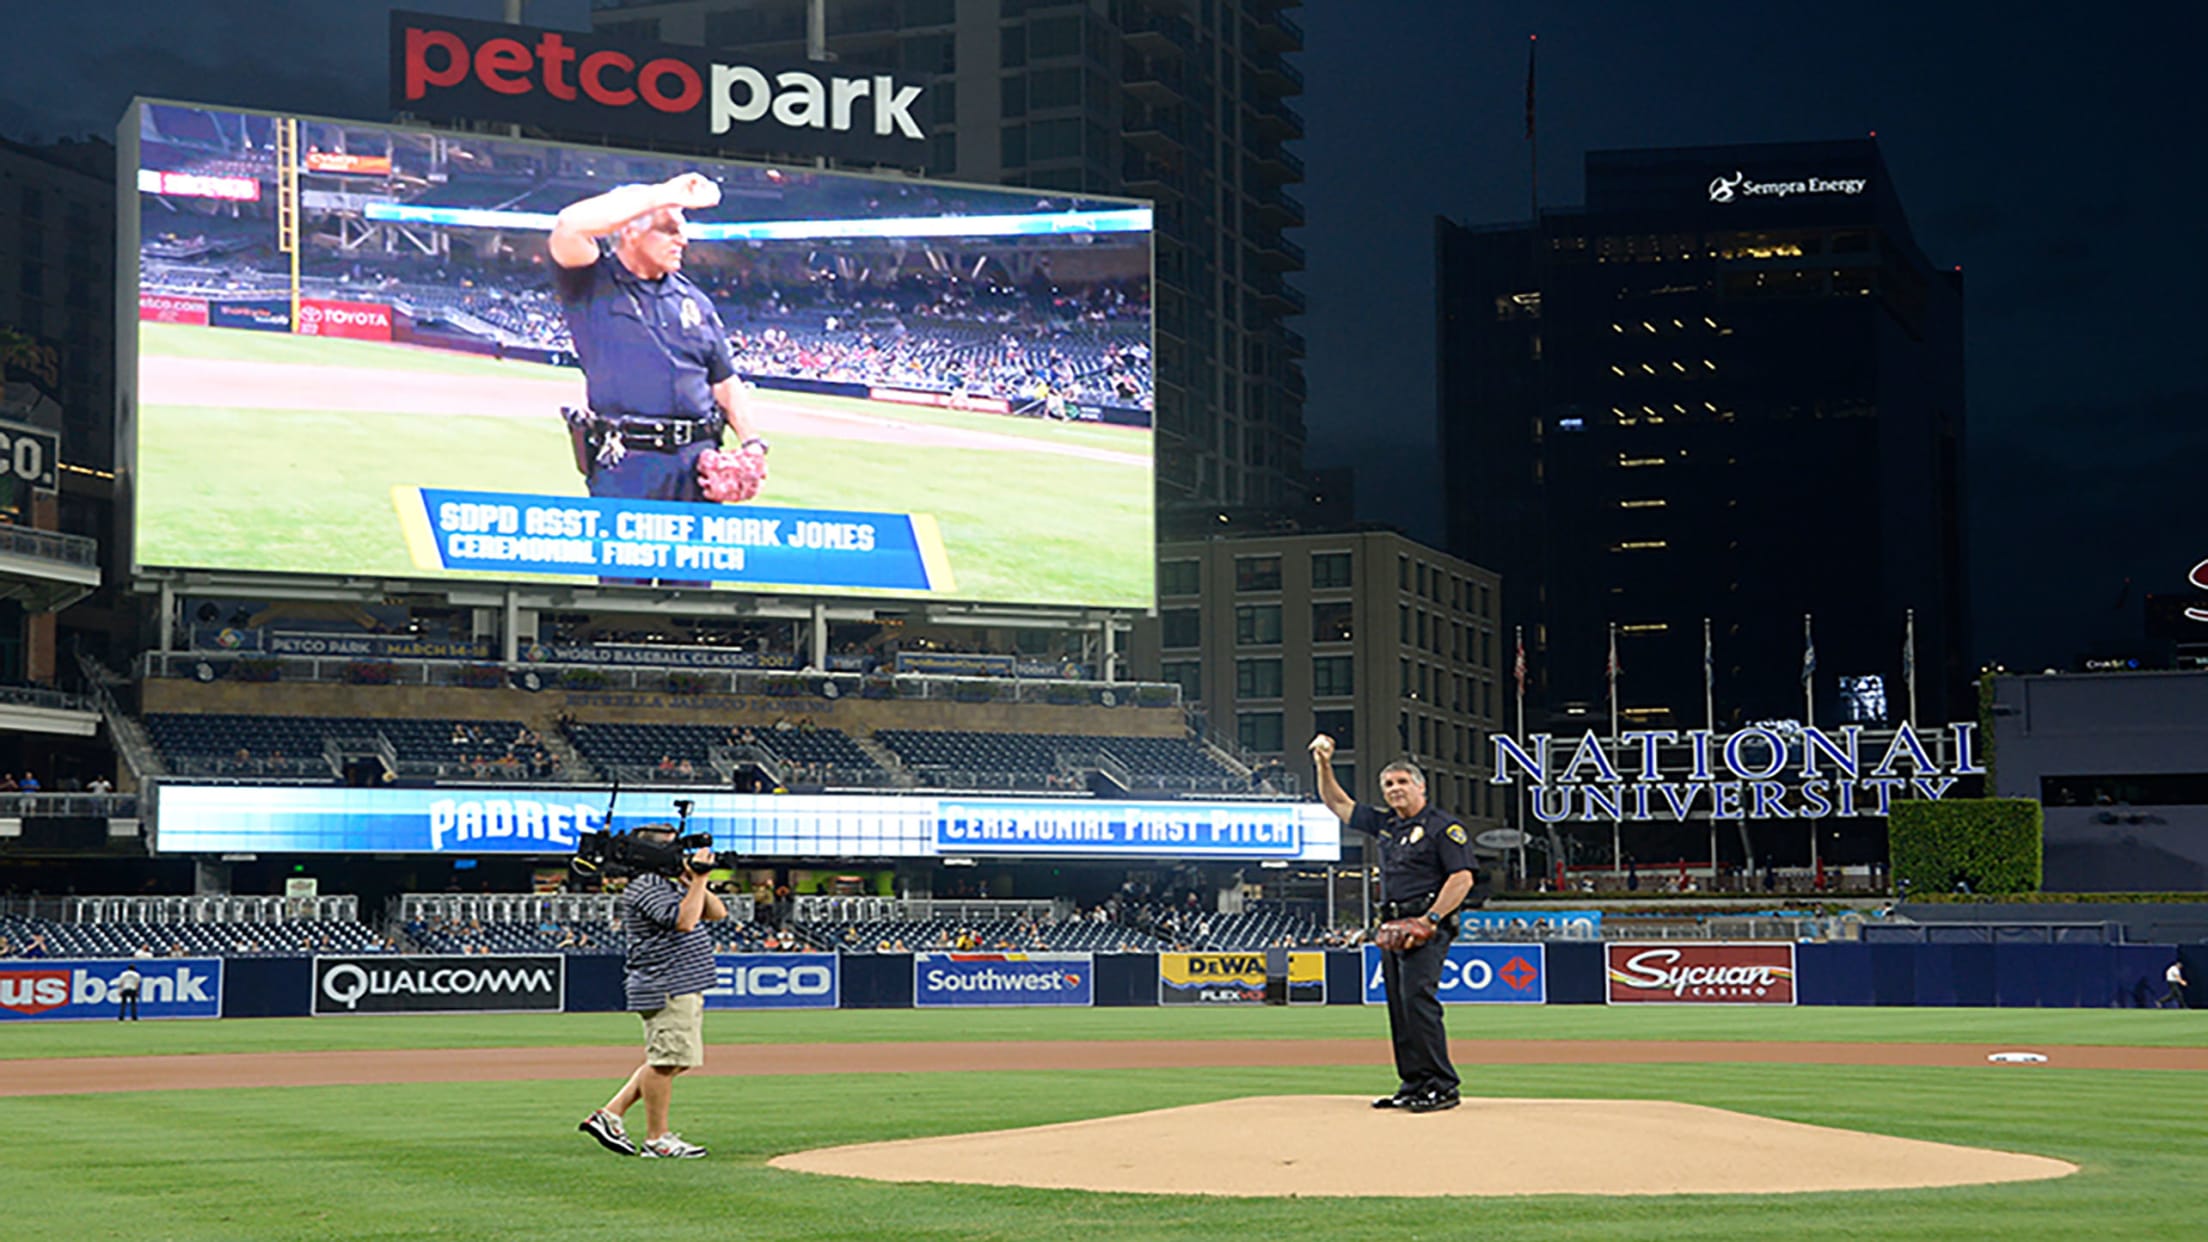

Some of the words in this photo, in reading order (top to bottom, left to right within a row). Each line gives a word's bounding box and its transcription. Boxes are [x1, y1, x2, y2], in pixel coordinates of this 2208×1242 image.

[1743, 181, 1805, 197] Sempra
[1808, 178, 1867, 194] Energy
[324, 308, 389, 327] TOYOTA
[439, 502, 519, 534] SDPD
[525, 506, 609, 538] ASST.
[616, 511, 695, 542] CHIEF
[702, 516, 781, 547] MARK
[787, 520, 875, 551] JONES
[448, 533, 597, 564] CEREMONIAL
[602, 541, 671, 567] FIRST
[675, 545, 745, 571] PITCH
[272, 638, 326, 653] PETCO
[329, 640, 371, 654] PARK
[387, 643, 447, 657] MARCH
[554, 648, 611, 661] WORLD
[614, 649, 690, 664] BASEBALL
[692, 652, 753, 667] CLASSIC
[1489, 720, 1987, 785] NATIONAL
[1189, 956, 1294, 975] DEWA
[1369, 958, 1493, 990] ACO
[1626, 949, 1777, 997] Sycuan
[1, 977, 67, 1004] us
[323, 963, 554, 1009] QUALCOMM
[702, 966, 832, 995] EICO
[927, 968, 1063, 993] Southwest
[1693, 986, 1767, 997] CASINO
[1201, 989, 1267, 1001] FLEXVO
